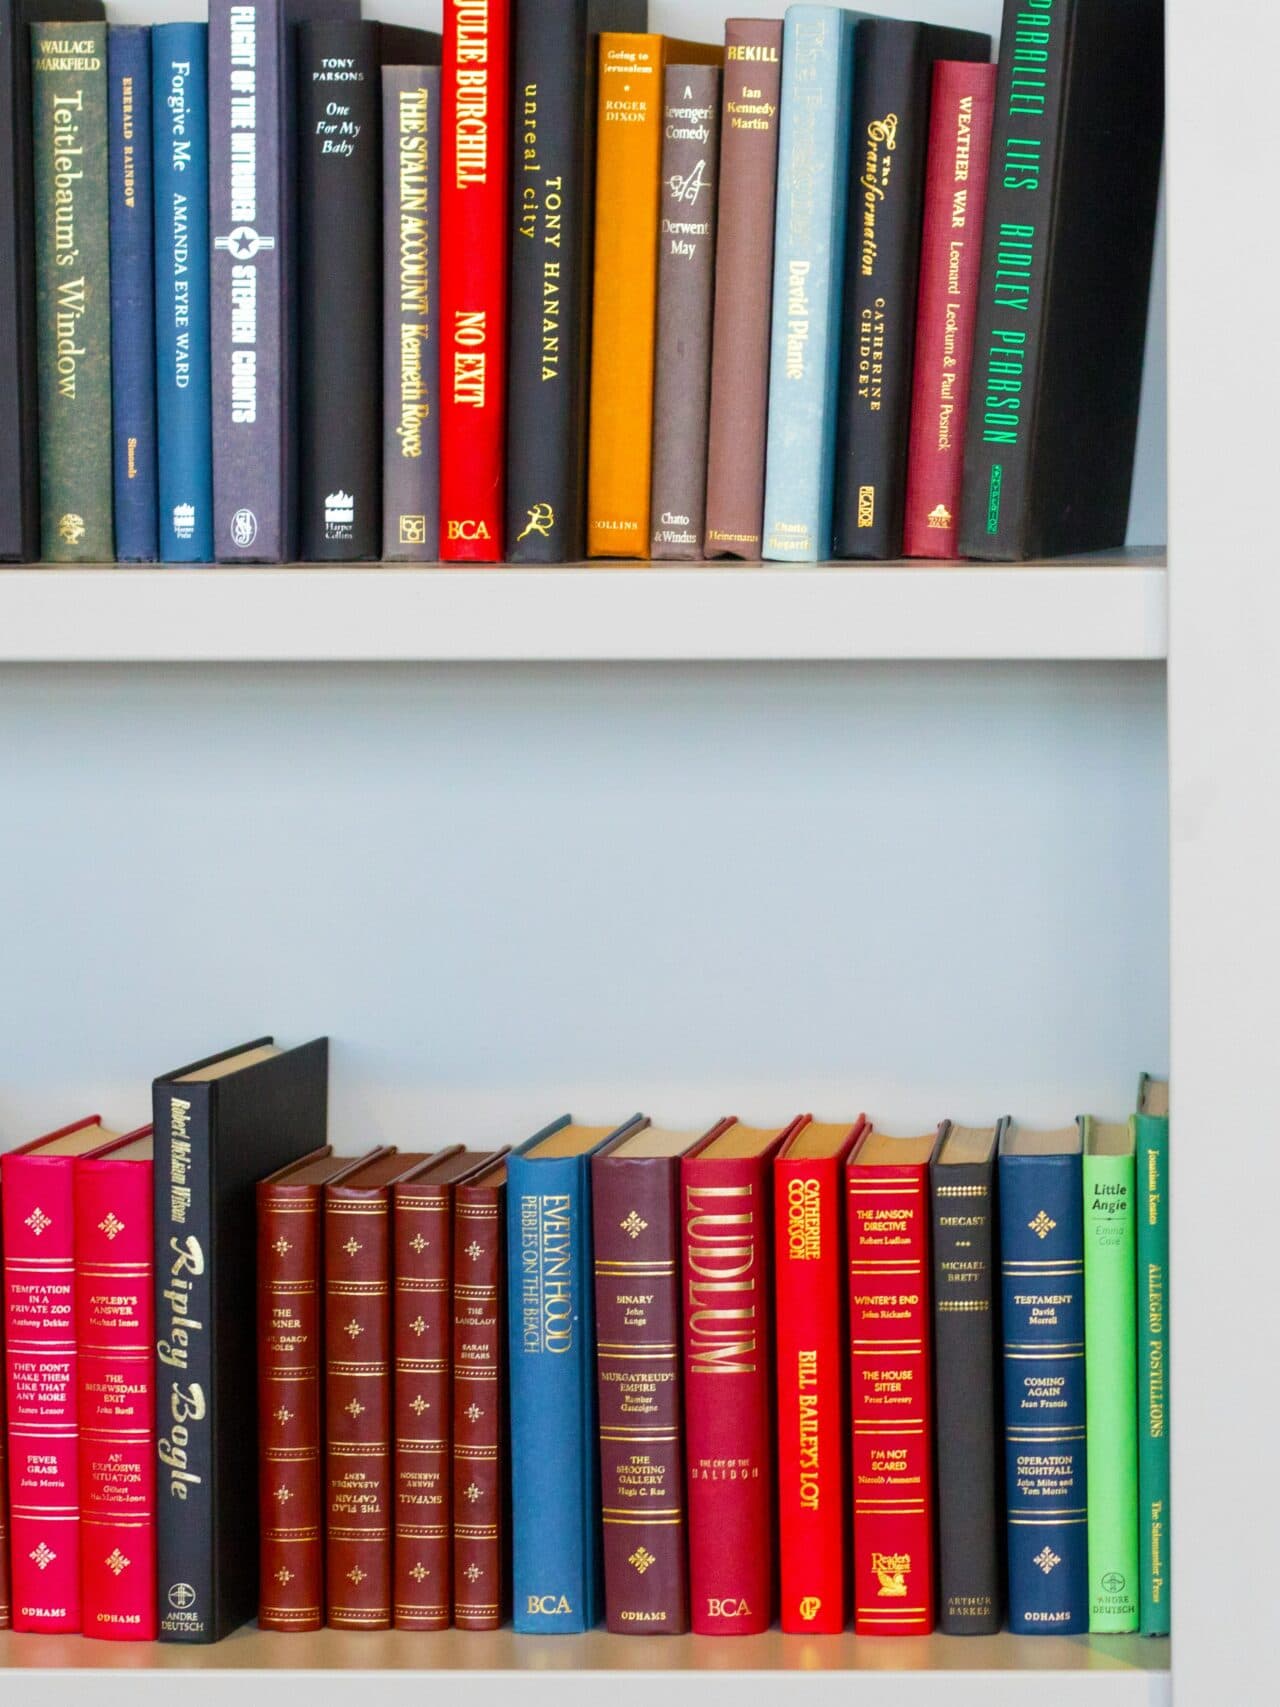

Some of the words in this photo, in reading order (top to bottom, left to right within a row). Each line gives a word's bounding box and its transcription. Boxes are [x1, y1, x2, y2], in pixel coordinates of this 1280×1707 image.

[453, 0, 488, 63] JULIE
[727, 45, 779, 64] REKILL
[321, 59, 355, 69] TONY
[167, 61, 191, 136] Forgive
[325, 102, 351, 117] One
[399, 88, 429, 132] THE
[605, 111, 646, 122] DIXON
[727, 102, 776, 118] Kennedy
[315, 121, 339, 136] For
[339, 121, 362, 138] My
[321, 139, 356, 157] Baby
[455, 68, 488, 189] BURCHILL
[524, 83, 541, 171] unreal
[953, 96, 973, 182] WEATHER
[52, 89, 84, 266] Teitlebaum's
[171, 140, 192, 172] Me
[399, 136, 430, 214] STALIN
[173, 192, 191, 276] AMANDA
[519, 187, 541, 239] city
[544, 176, 562, 249] TONY
[950, 189, 969, 229] WAR
[400, 215, 429, 315] ACCOUNT
[669, 242, 698, 261] May
[992, 223, 1036, 311] RIDLEY
[174, 279, 192, 329] EYRE
[786, 259, 811, 316] David
[54, 276, 86, 400] Window
[454, 310, 486, 347] NO
[541, 261, 561, 381] HANANIA
[175, 332, 192, 389] WARD
[400, 323, 427, 401] Kenneth
[786, 320, 810, 380] Plante
[856, 308, 872, 400] CHIDGEY
[868, 296, 887, 412] CATHERINE
[454, 351, 486, 408] EXIT
[983, 329, 1028, 444] PEARSON
[397, 402, 425, 458] Royce
[447, 518, 492, 540] BCA
[1093, 1182, 1128, 1198] Little
[1145, 1148, 1162, 1193] Jonathan
[519, 1194, 540, 1253] PEBBLES
[787, 1178, 806, 1262] COOKSON
[857, 1208, 875, 1220] THE
[876, 1208, 914, 1220] JANSON
[1091, 1197, 1128, 1214] Angie
[1146, 1194, 1160, 1227] Keates
[542, 1194, 572, 1276] EVELYN
[521, 1253, 540, 1273] ON
[685, 1183, 757, 1375] LUDLUM
[157, 1235, 205, 1369] Ripley
[521, 1274, 540, 1305] THE
[854, 1294, 898, 1307] WINTER'S
[898, 1294, 920, 1306] END
[1148, 1262, 1165, 1335] ALLEGRO
[522, 1307, 541, 1354] BEACH
[543, 1280, 574, 1354] HOOD
[798, 1350, 819, 1390] BILL
[862, 1370, 879, 1381] THE
[880, 1369, 914, 1381] HOUSE
[1023, 1376, 1066, 1388] COMING
[1149, 1338, 1166, 1439] POSTILLIONS
[157, 1380, 206, 1501] Bogle
[798, 1394, 820, 1469] BAILEY'S
[27, 1455, 58, 1465] FEVER
[27, 1464, 59, 1475] GRASS
[629, 1455, 651, 1466] THE
[871, 1460, 908, 1472] SCARED
[799, 1474, 820, 1511] LOT
[162, 1610, 201, 1622] ANDRE
[526, 1595, 573, 1614] BCA
[706, 1597, 753, 1618] BCA
